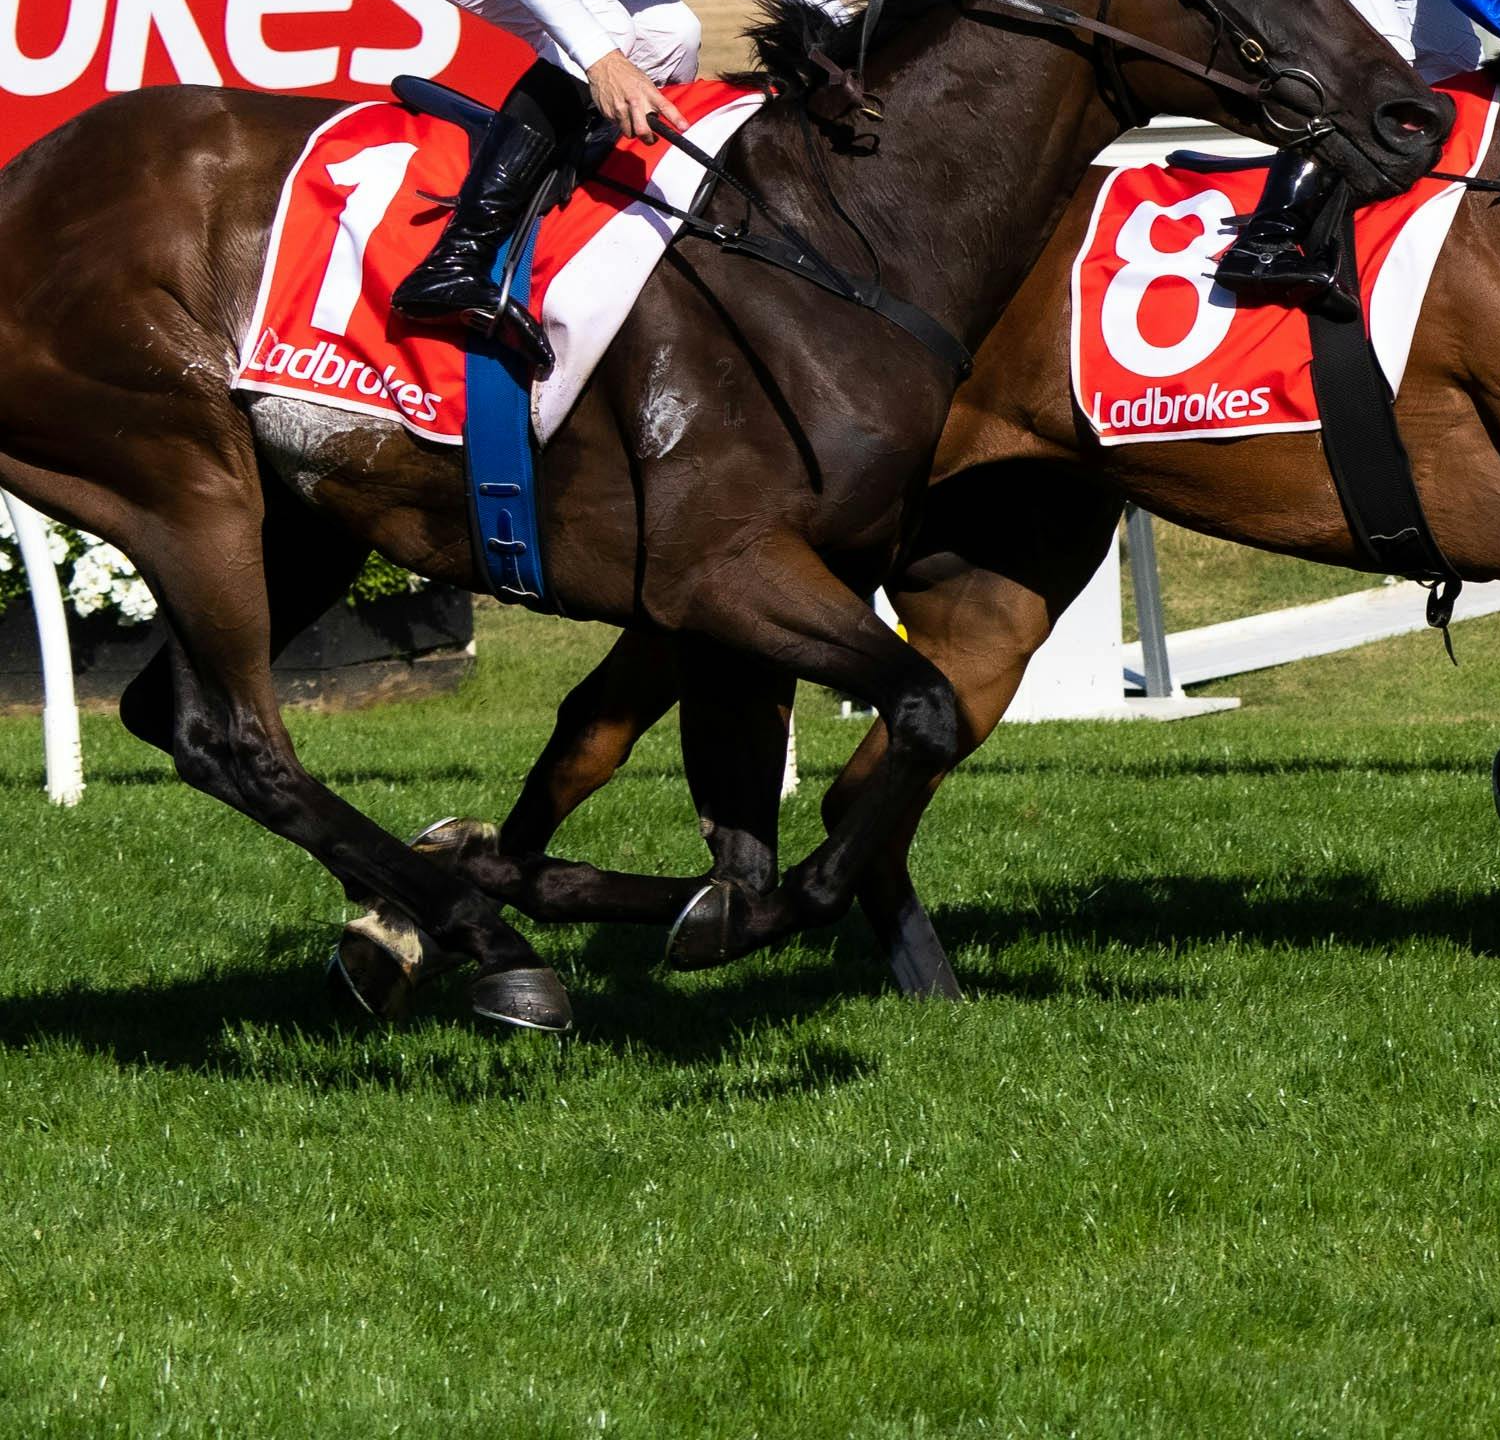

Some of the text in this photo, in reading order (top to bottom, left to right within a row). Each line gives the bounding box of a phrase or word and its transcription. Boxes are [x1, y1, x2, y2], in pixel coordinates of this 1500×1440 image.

[311, 142, 420, 336] 1
[1101, 189, 1239, 378] 8
[247, 326, 443, 422] Ladbrokes
[1093, 383, 1271, 433] Ladbrokes
